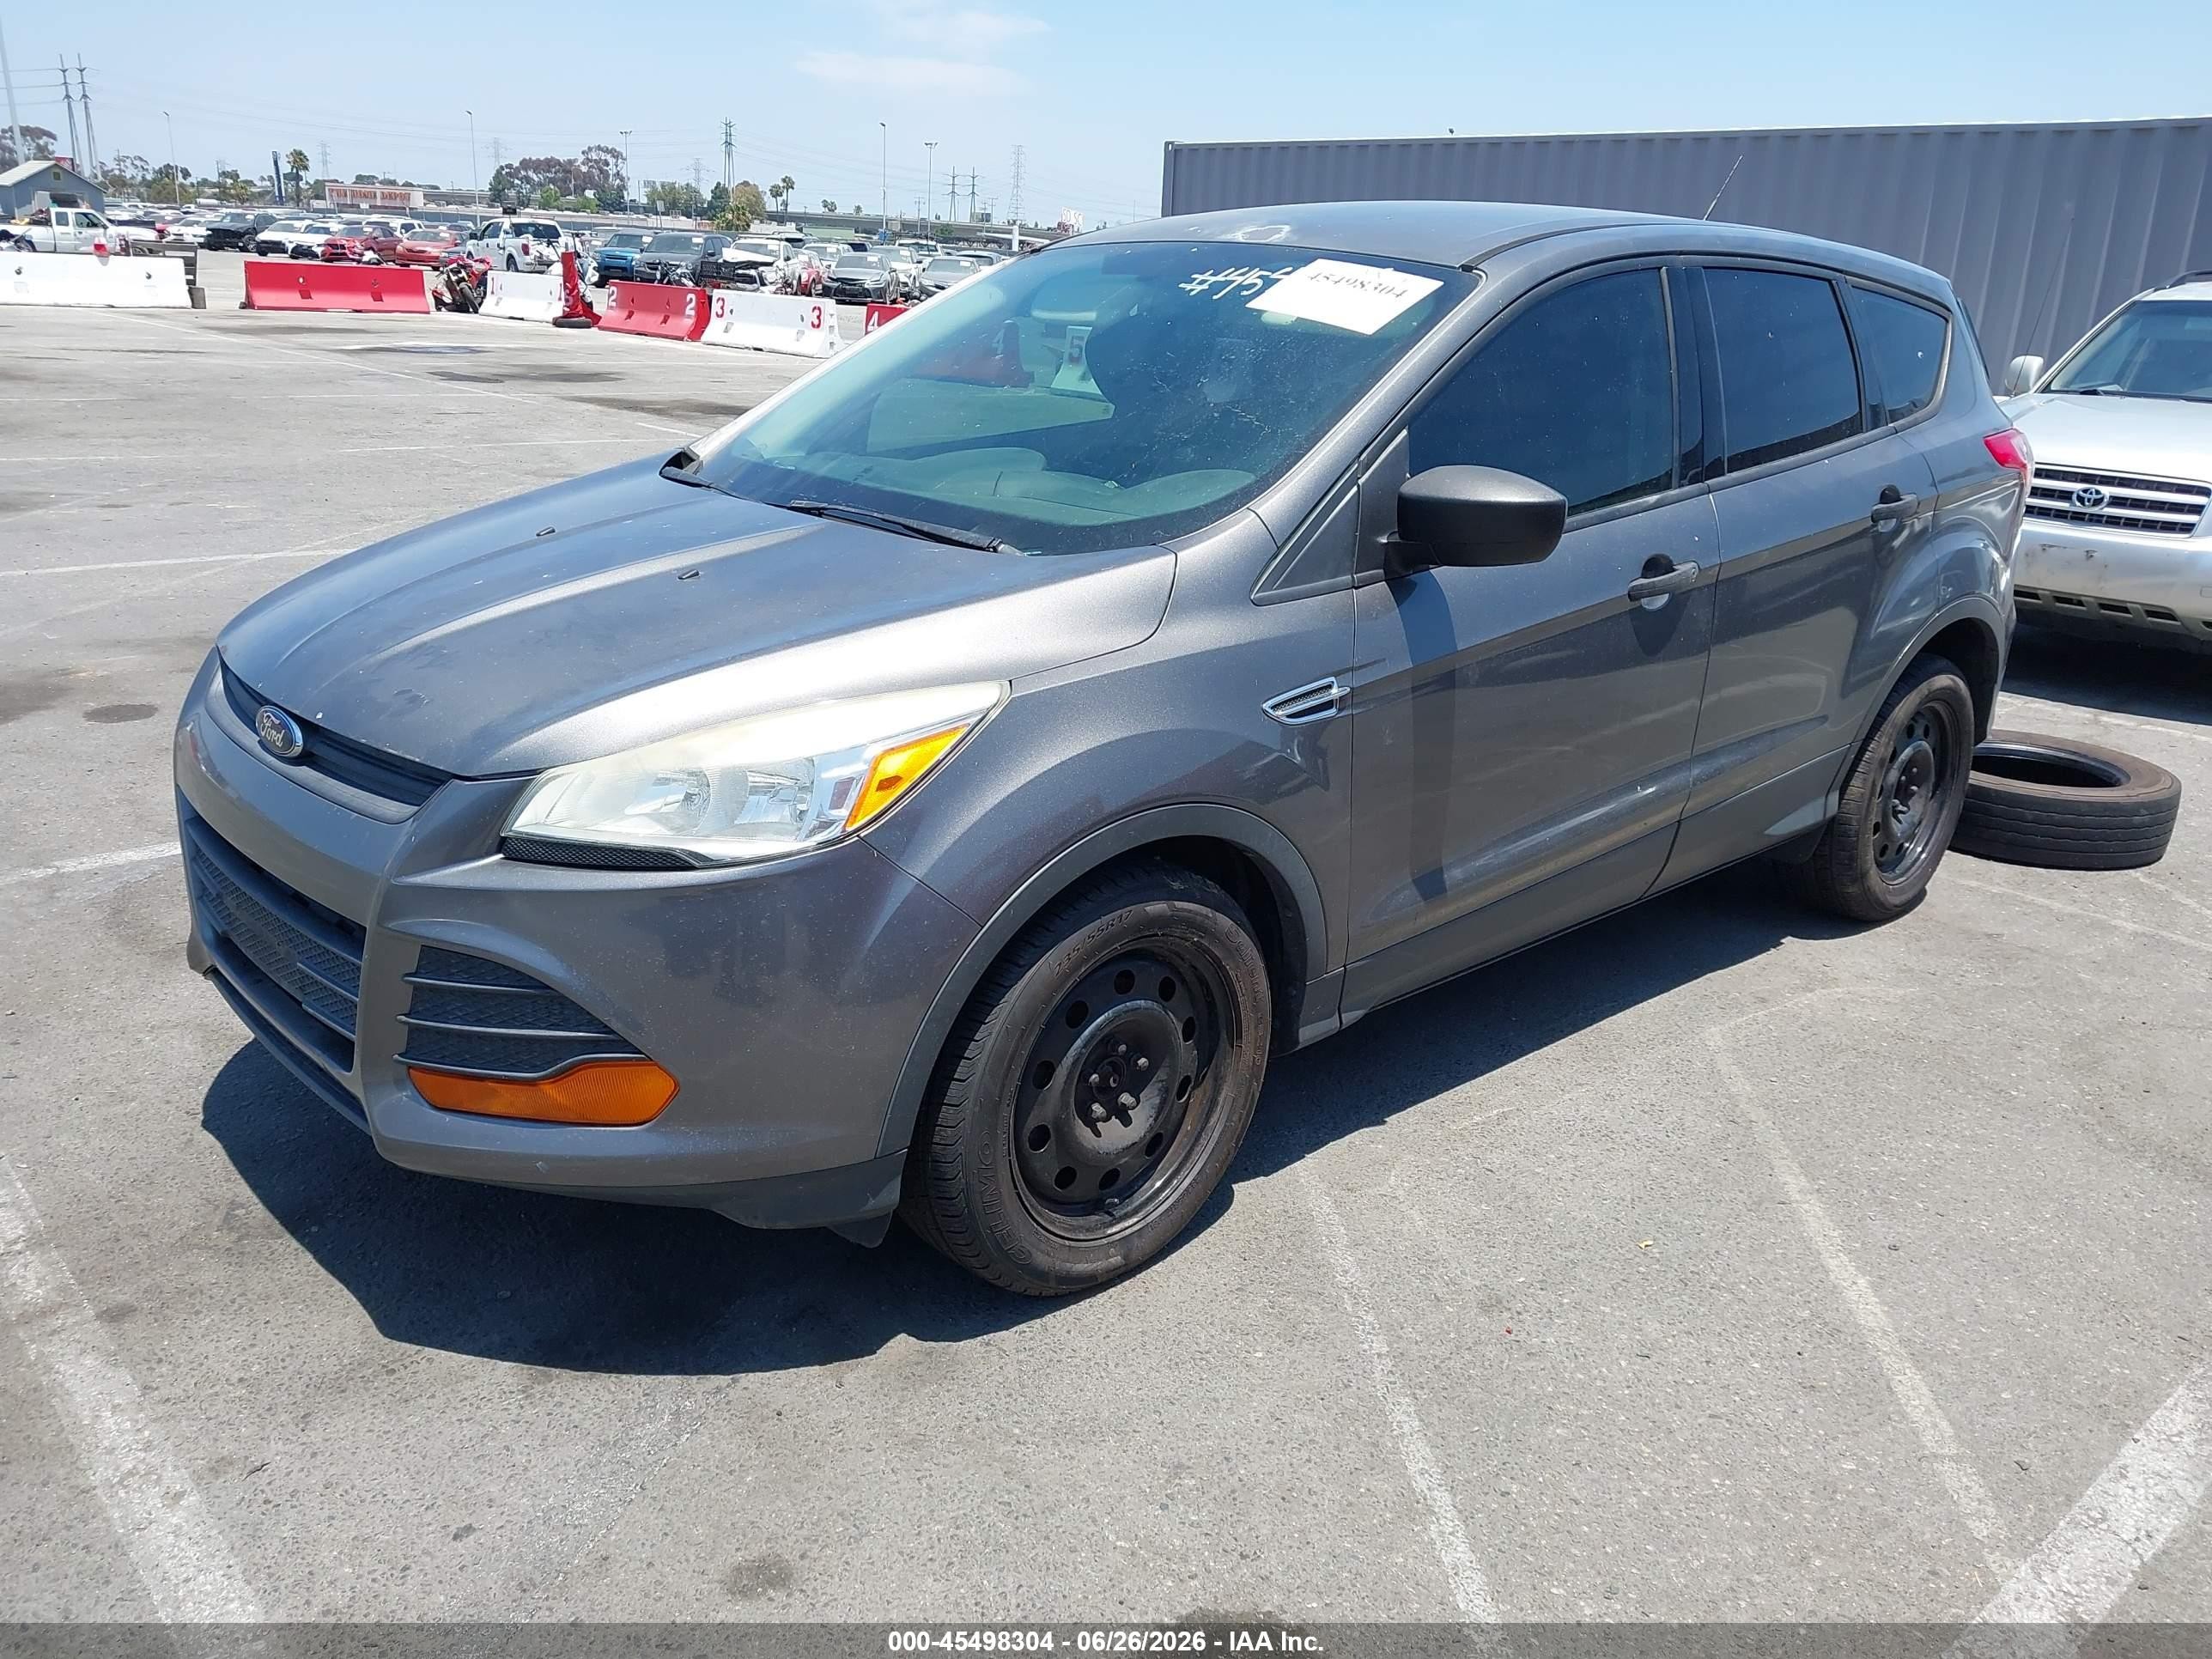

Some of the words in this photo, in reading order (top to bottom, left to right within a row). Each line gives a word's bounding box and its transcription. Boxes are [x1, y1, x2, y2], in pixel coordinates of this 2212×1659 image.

[608, 286, 617, 307] 2
[685, 293, 696, 316] 2
[715, 297, 726, 319] 3
[811, 306, 822, 329] 3
[866, 310, 880, 331] 4
[260, 711, 285, 747] Ford
